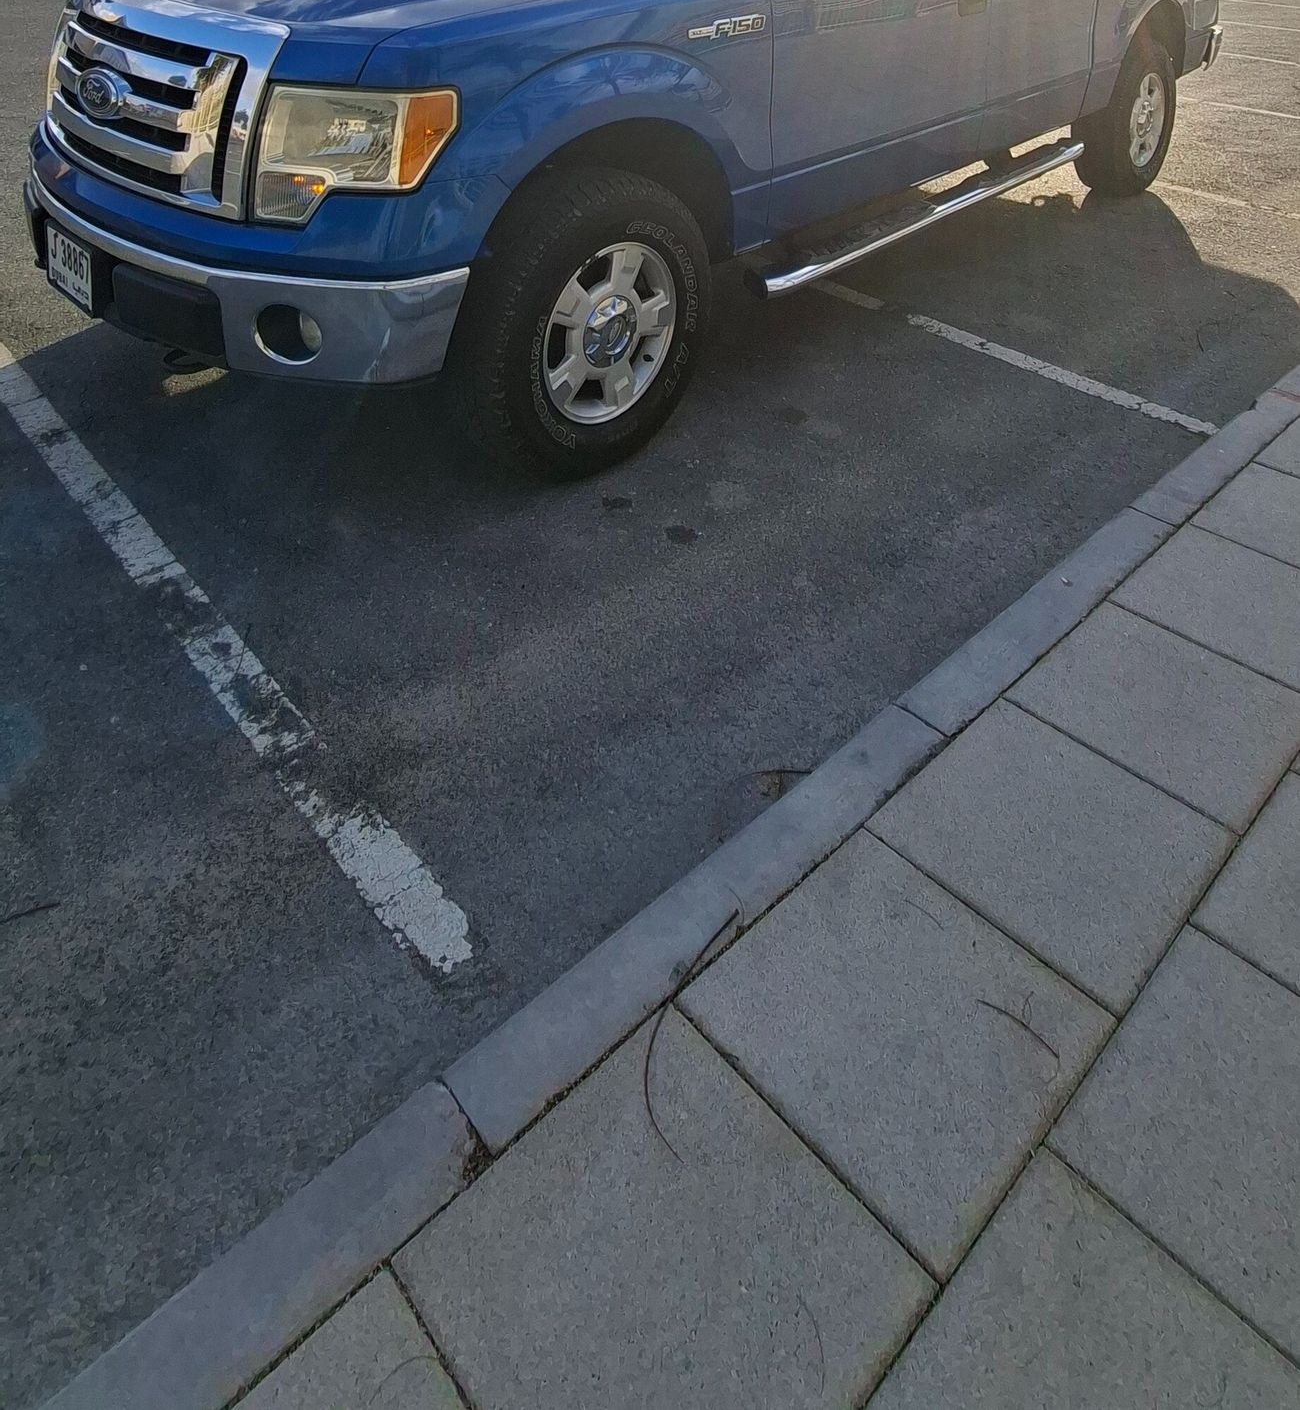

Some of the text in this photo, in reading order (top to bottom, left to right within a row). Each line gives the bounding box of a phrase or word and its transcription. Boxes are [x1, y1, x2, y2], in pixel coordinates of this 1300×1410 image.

[83, 78, 105, 104] Ford
[51, 232, 59, 259] J
[51, 266, 69, 288] DUBAI
[529, 315, 576, 450] YOKOHAMA
